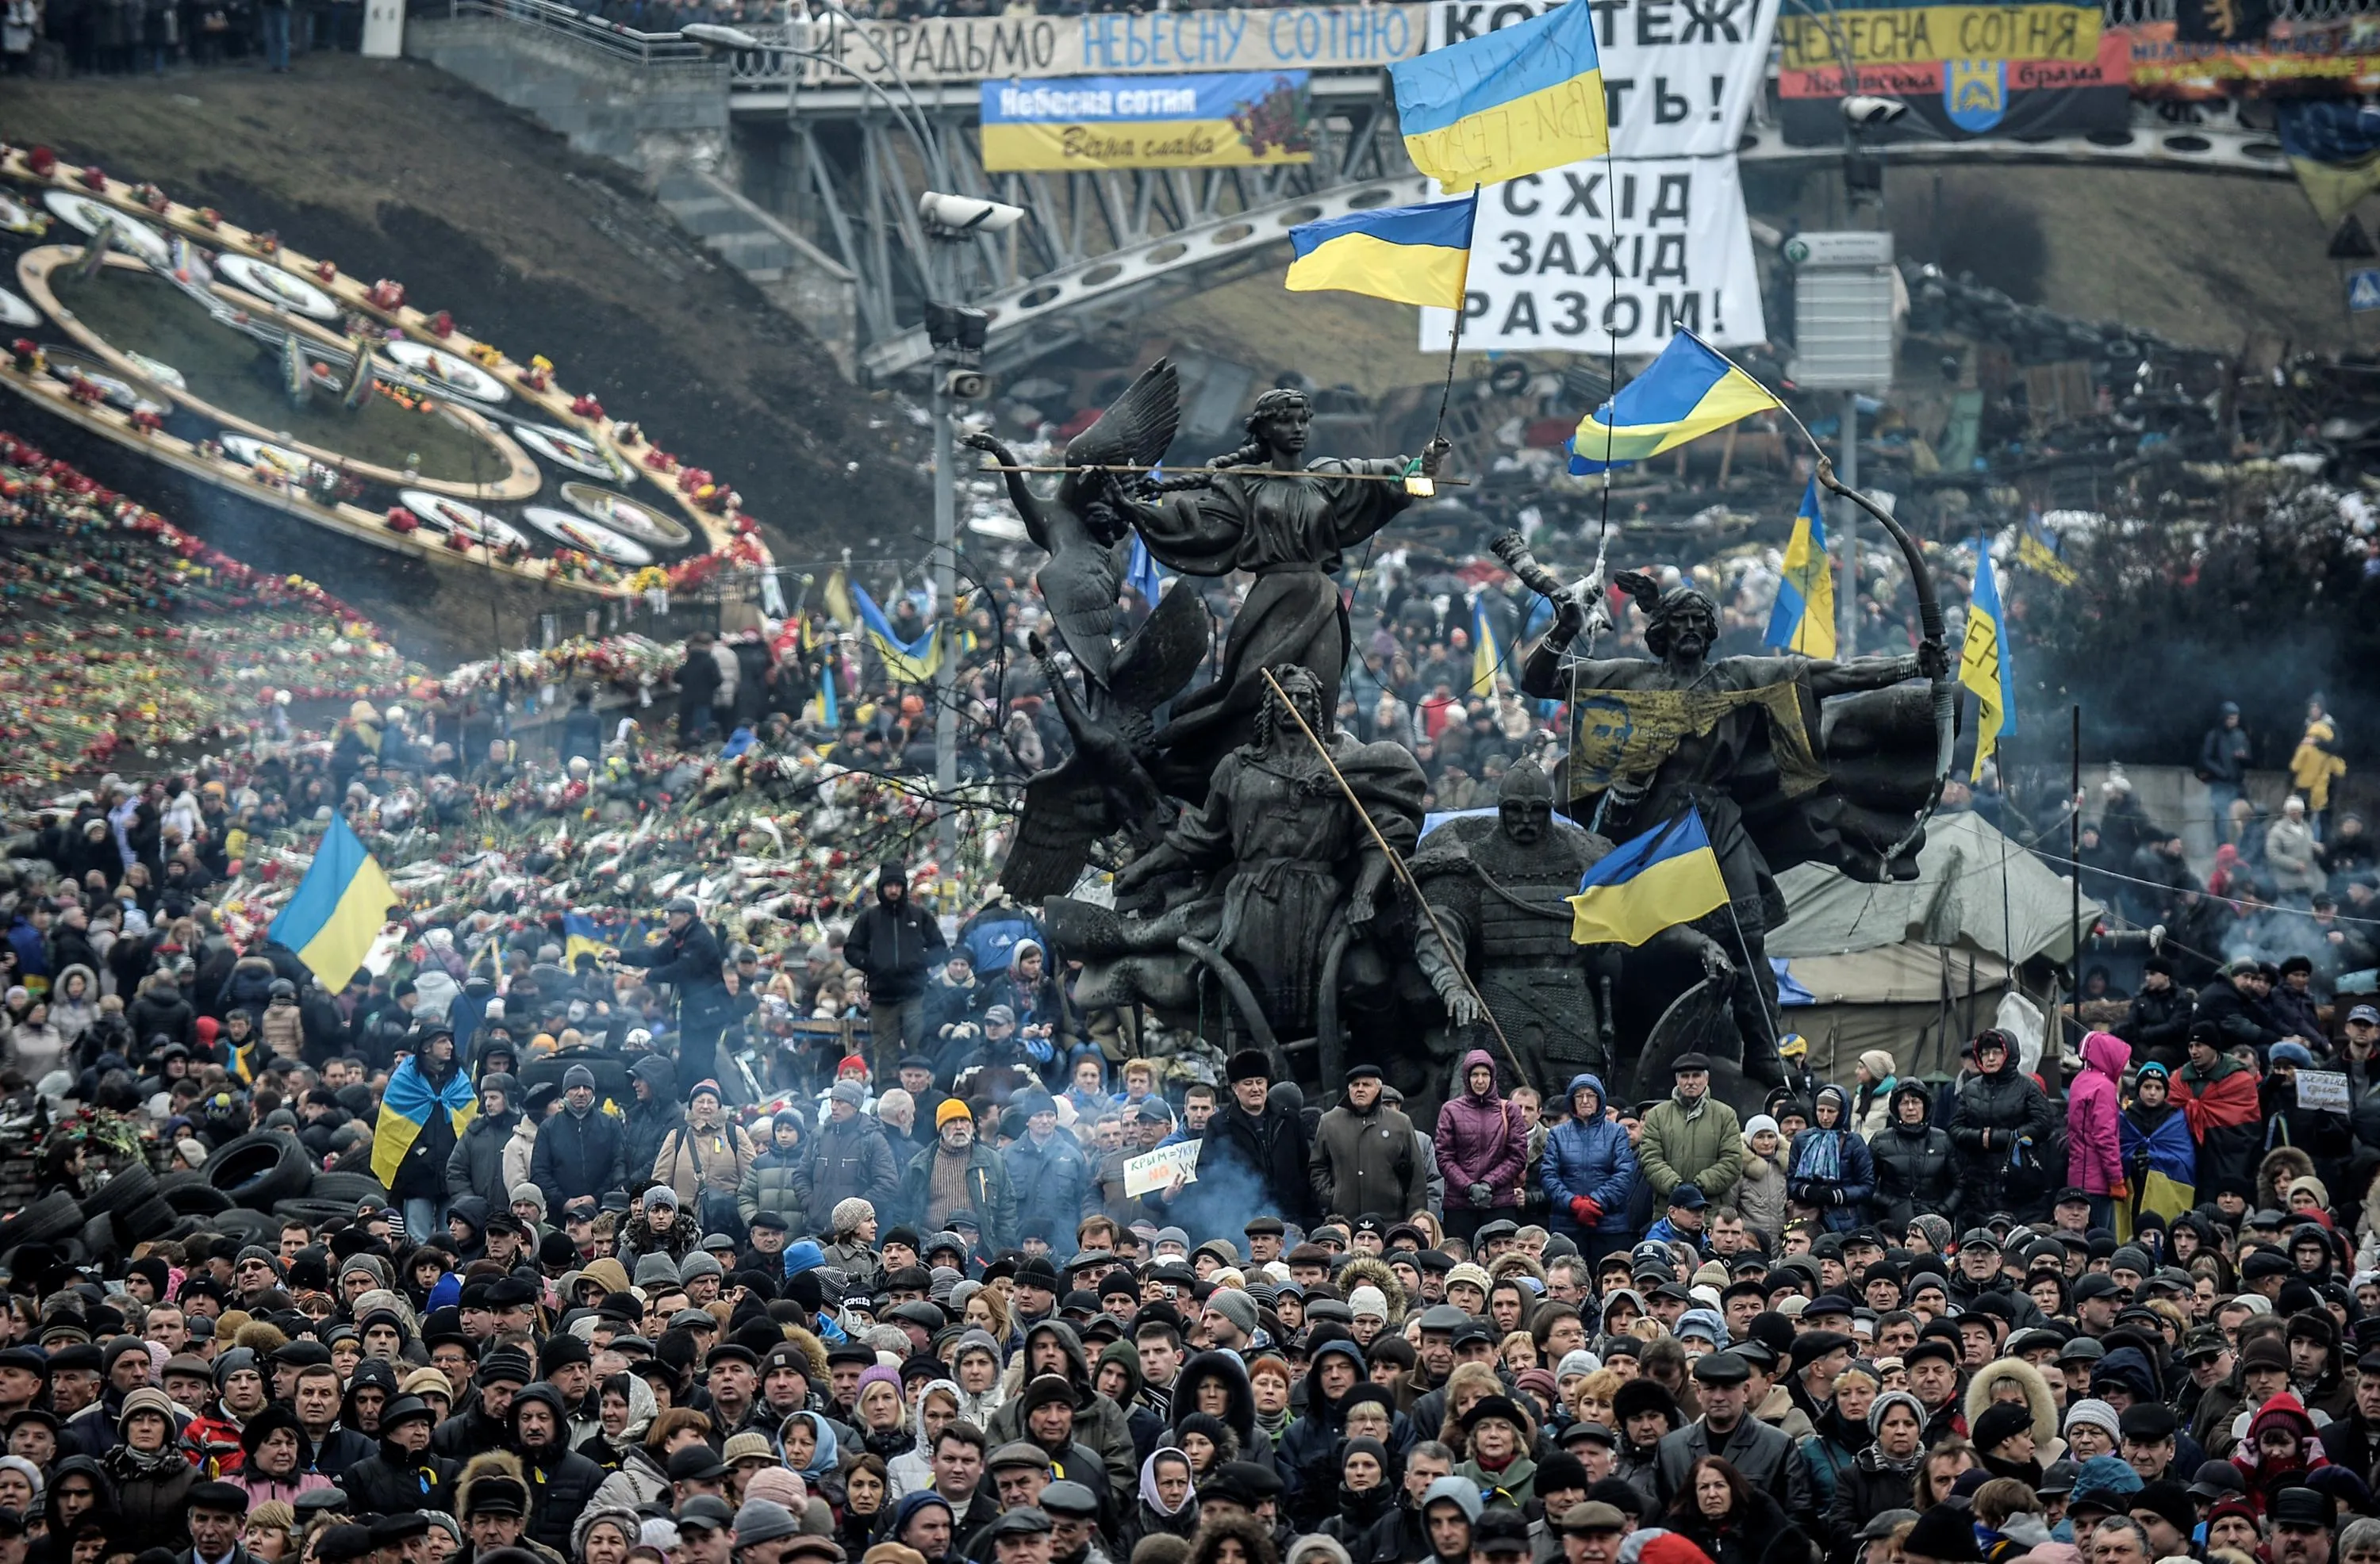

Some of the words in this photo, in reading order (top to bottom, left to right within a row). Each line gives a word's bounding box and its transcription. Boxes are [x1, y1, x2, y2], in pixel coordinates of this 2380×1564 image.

[864, 20, 1055, 73] ЗРАДЬМО
[1082, 11, 1248, 67] НЕБЕСНУ
[1269, 8, 1411, 61] СОТНЮ
[1445, 0, 1741, 46] КОТЕЖ
[1959, 9, 2079, 56] СОТНЯ
[1603, 76, 1725, 128] ТЬ!
[1503, 172, 1691, 228] СХІД
[1497, 231, 1689, 287] ЗАХІД
[1460, 289, 1726, 339] РАЗОМ!
[1130, 1152, 1167, 1171] КРЫМ
